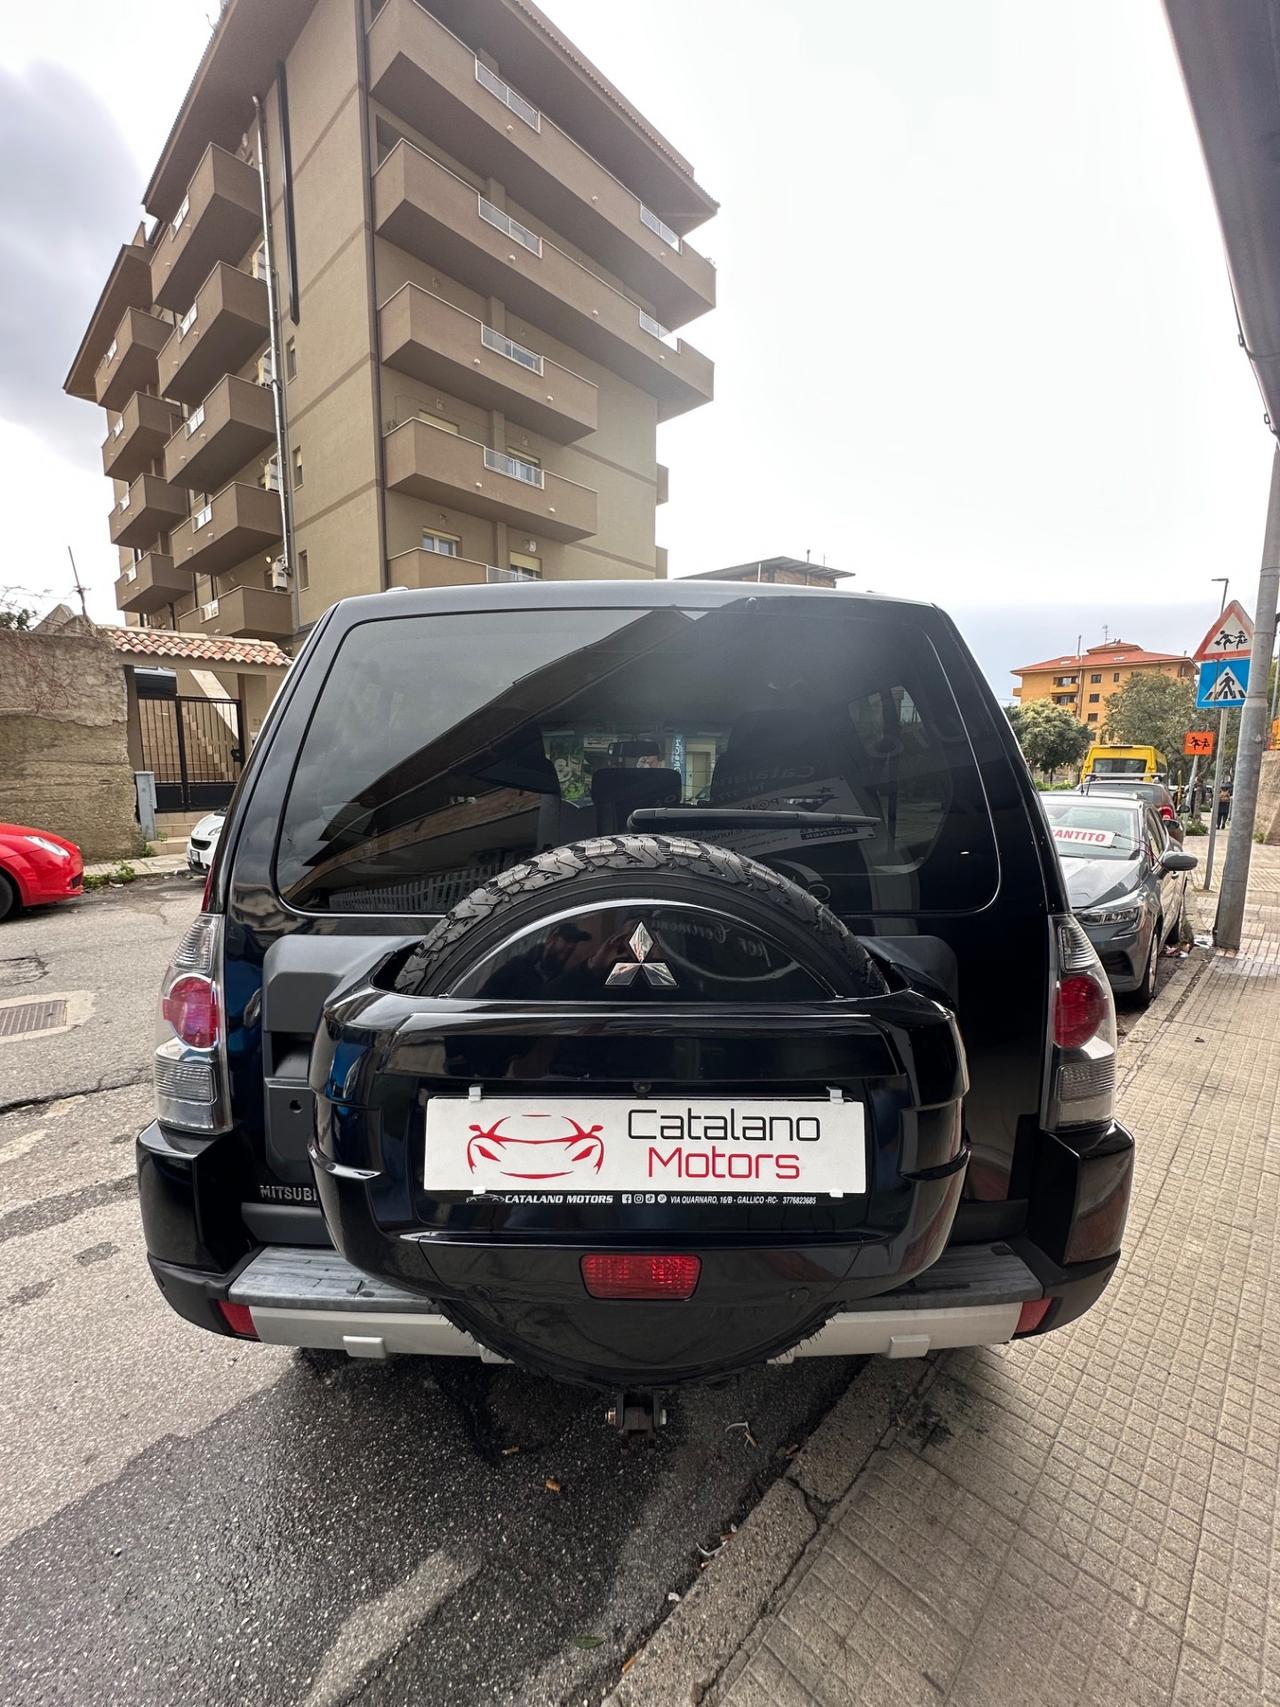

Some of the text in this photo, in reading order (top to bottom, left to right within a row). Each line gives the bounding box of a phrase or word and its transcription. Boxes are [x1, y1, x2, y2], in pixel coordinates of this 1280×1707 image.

[1052, 829, 1106, 842] ANTITO
[628, 1107, 821, 1142] Catalano
[648, 1145, 800, 1179] Motors
[260, 1185, 317, 1201] MITSUBI
[505, 1194, 614, 1204] CATALANO MOTORS
[670, 1195, 681, 1204] VIA
[737, 1196, 765, 1204] GALLICO
